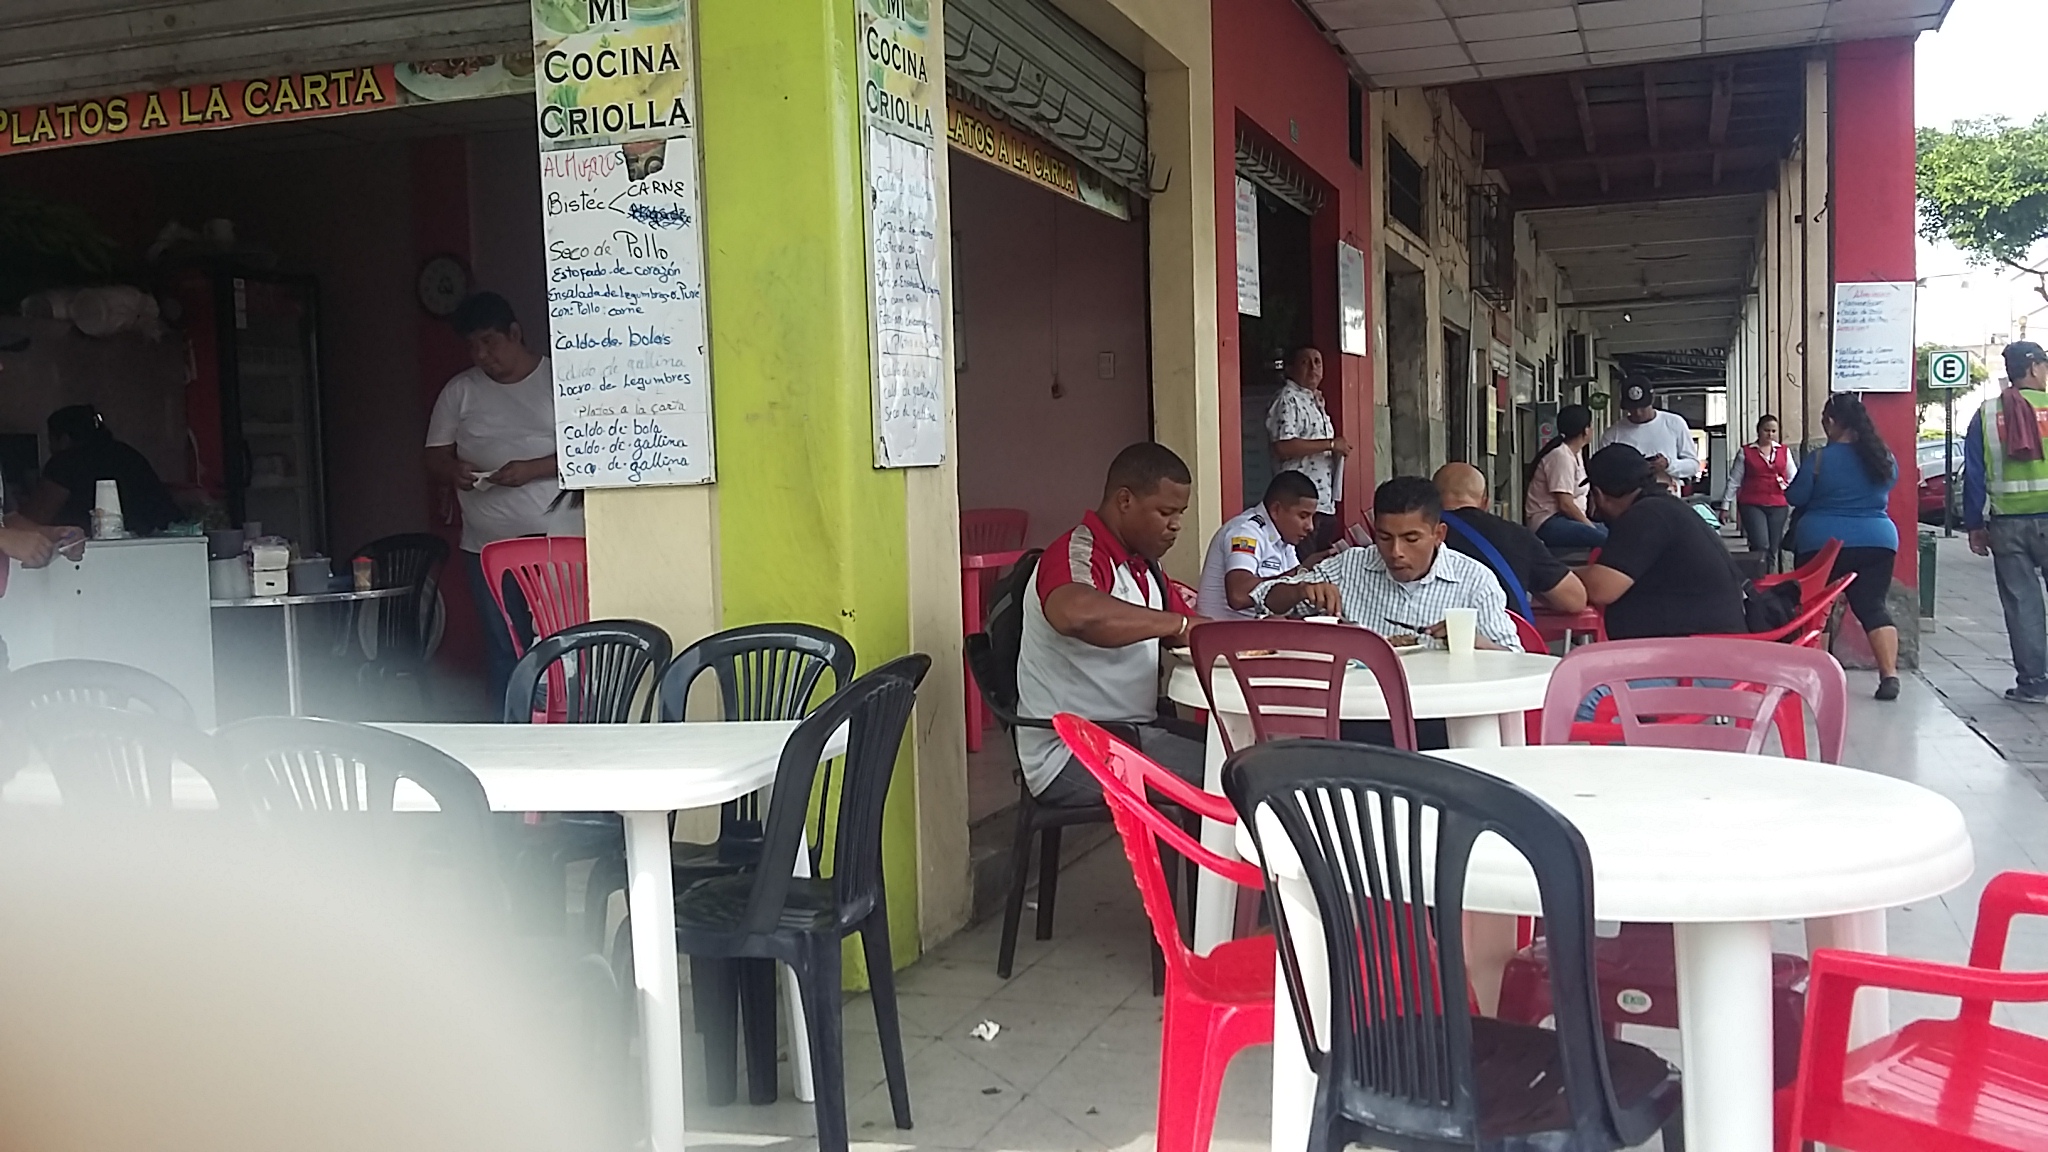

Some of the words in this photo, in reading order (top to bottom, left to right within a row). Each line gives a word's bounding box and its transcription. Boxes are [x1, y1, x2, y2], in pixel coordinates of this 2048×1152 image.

[588, 0, 628, 25] MI
[544, 43, 681, 84] COCINA
[866, 26, 928, 83] COCINA
[141, 94, 169, 129] A
[181, 87, 231, 124] LA
[244, 67, 384, 116] CARTA
[540, 97, 691, 139] CRIOLLA
[866, 79, 933, 135] CRIOLLA
[945, 111, 995, 157] LATOS
[998, 132, 1010, 165] A
[1012, 137, 1030, 174] LA
[1033, 149, 1075, 193] CARTA
[613, 230, 669, 259] Pollo
[1943, 359, 1956, 379] E
